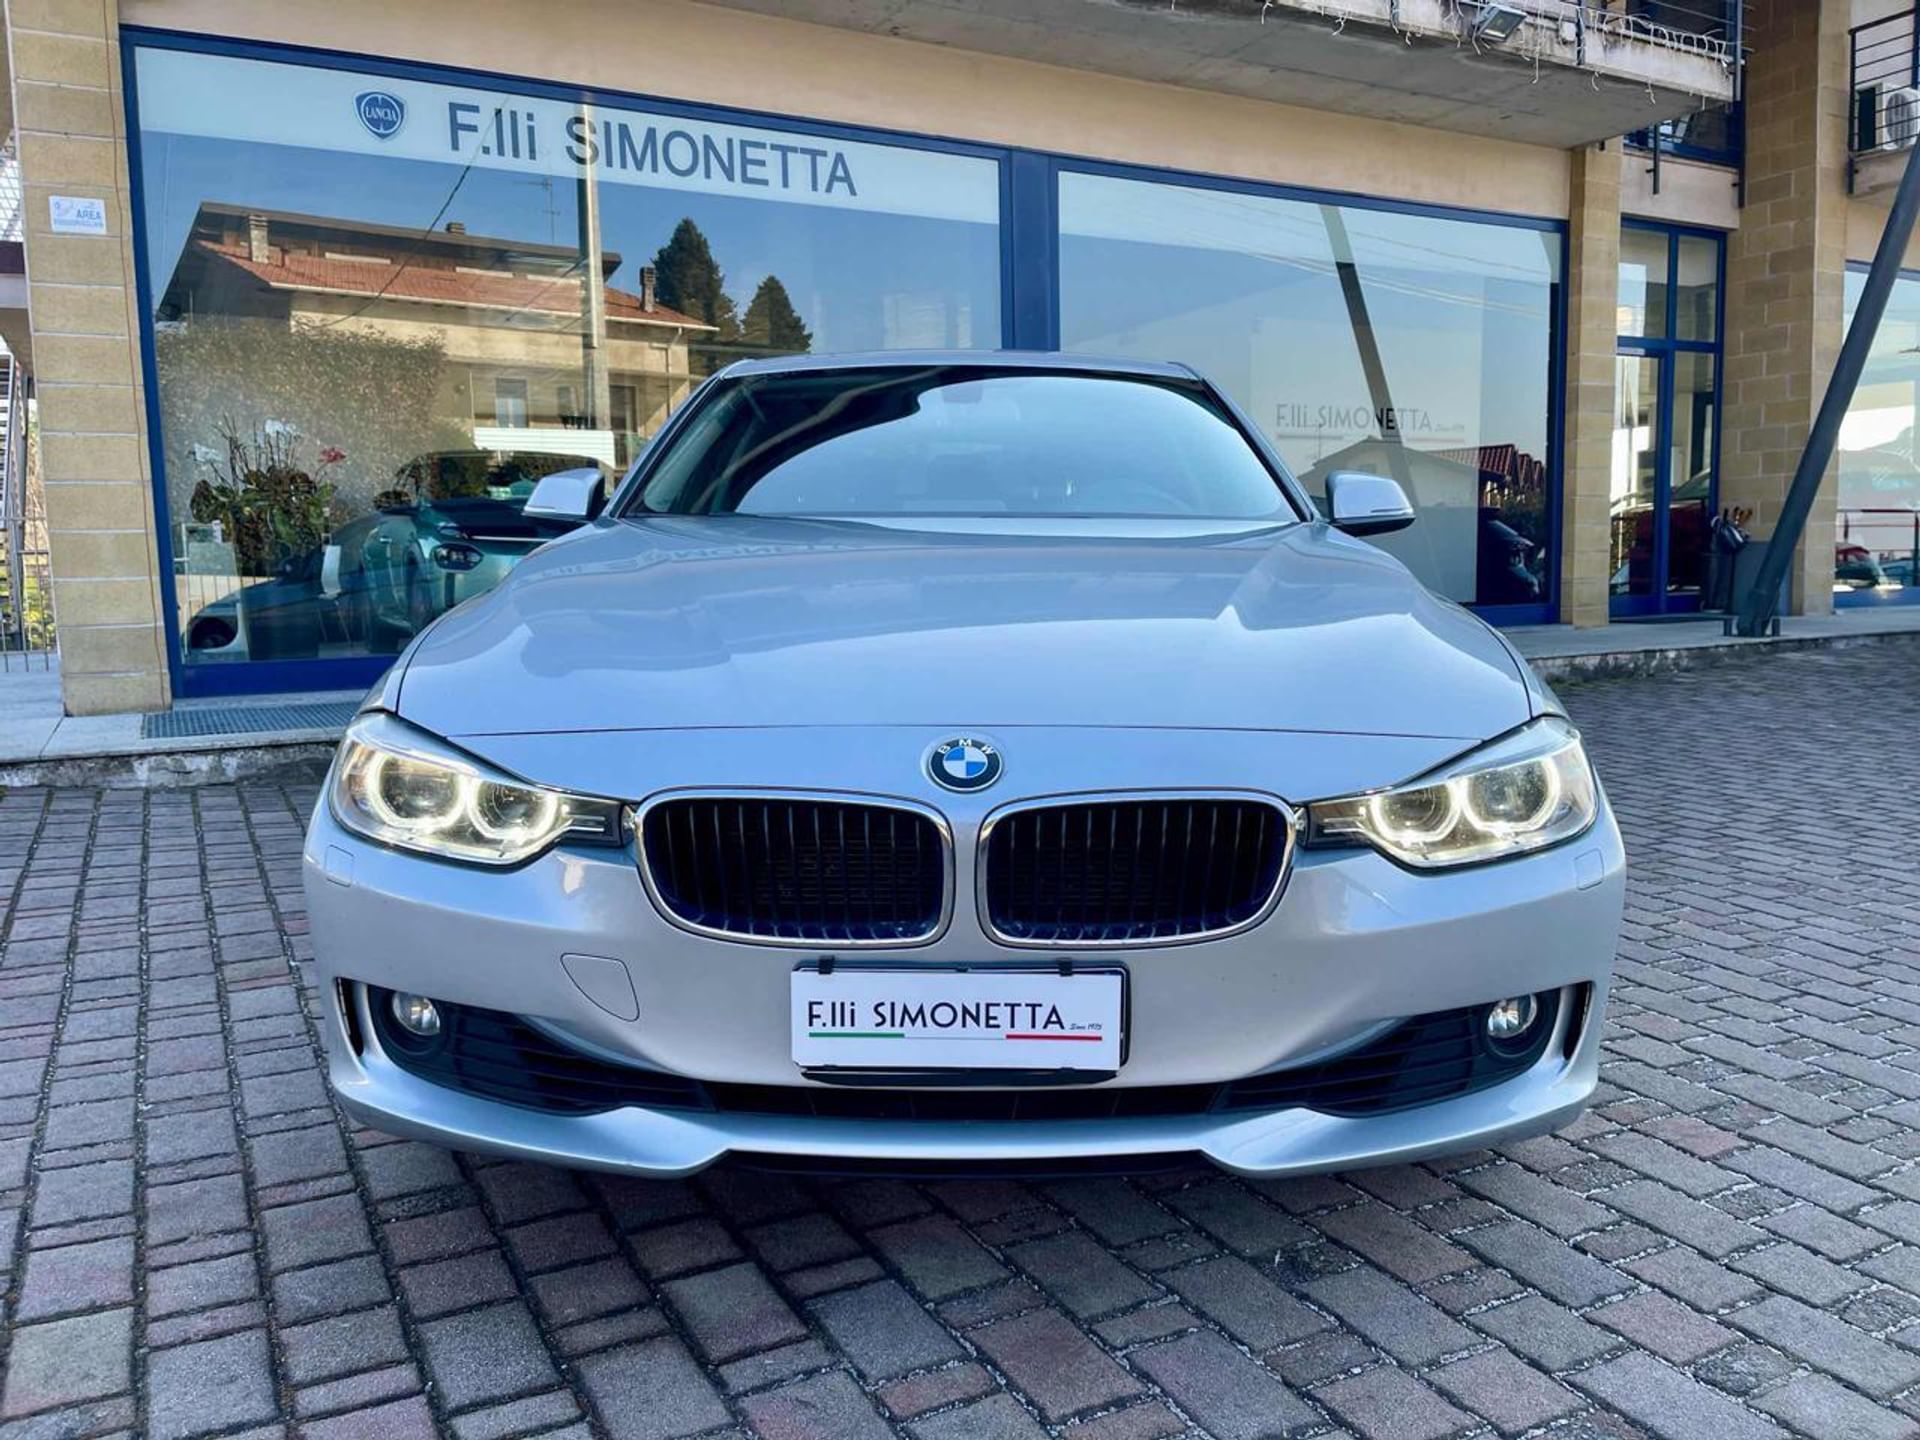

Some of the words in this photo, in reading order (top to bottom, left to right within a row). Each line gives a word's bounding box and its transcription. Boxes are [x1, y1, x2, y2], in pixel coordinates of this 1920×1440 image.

[366, 105, 397, 122] LANCIA
[448, 102, 537, 160] F.lli
[565, 115, 857, 196] SIMONETTA
[76, 208, 102, 220] AREA
[1318, 406, 1432, 431] SIMONETTA
[937, 738, 995, 754] BMW
[808, 1001, 856, 1028] F.lli
[873, 1001, 1065, 1030] SIMONETTA
